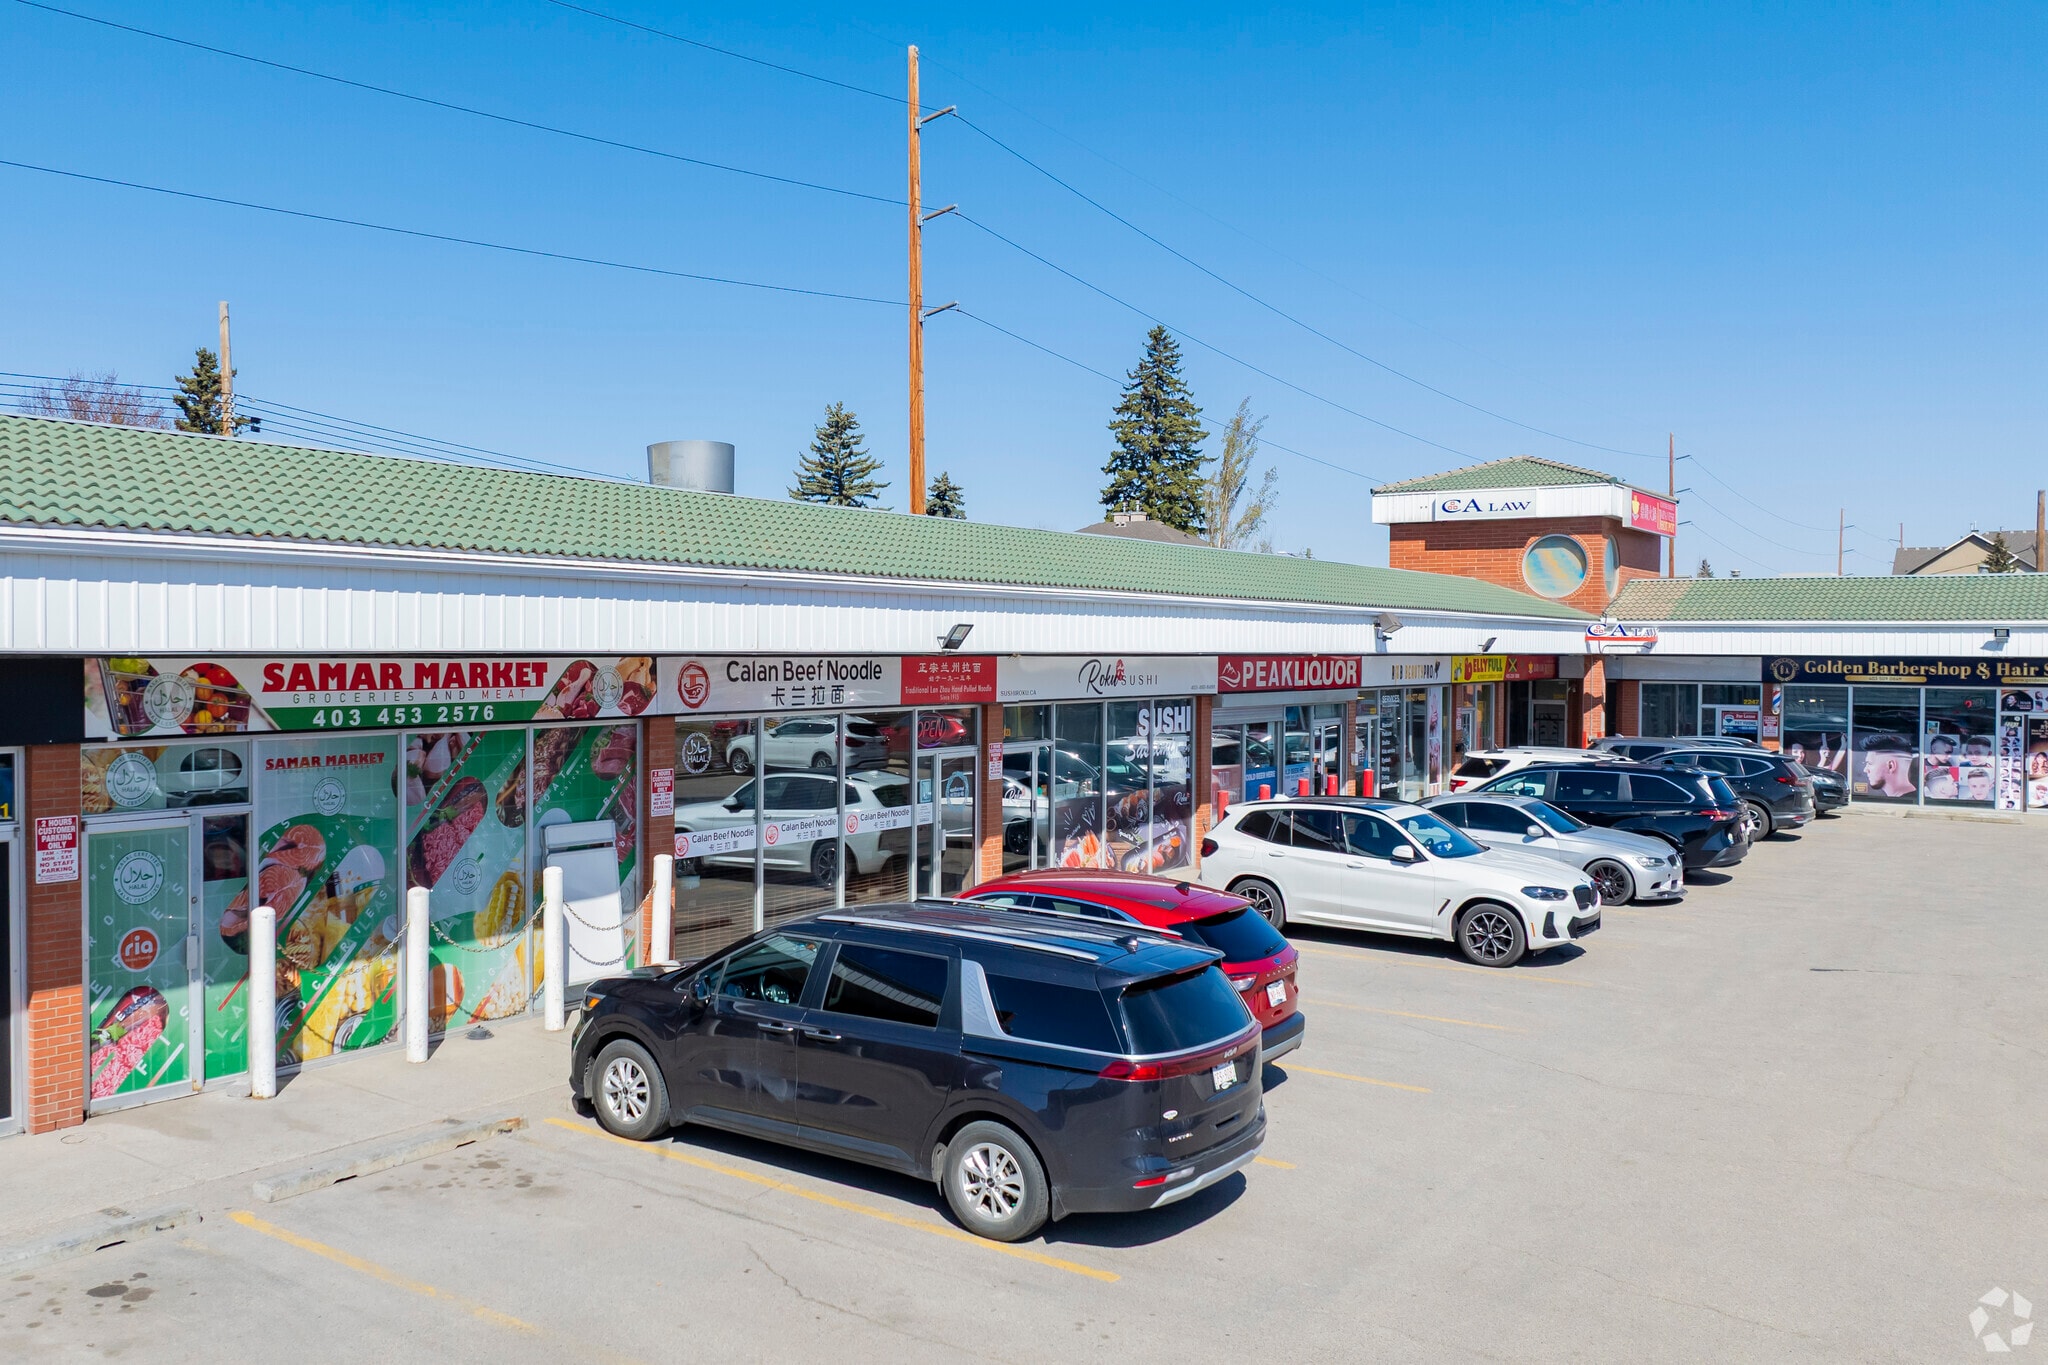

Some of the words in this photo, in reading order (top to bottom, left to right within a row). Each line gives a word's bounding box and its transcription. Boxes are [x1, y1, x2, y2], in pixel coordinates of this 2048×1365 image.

[1441, 498, 1483, 513] CA
[1489, 501, 1531, 512] LAW
[1587, 624, 1629, 637] CA
[1631, 627, 1660, 637] LAW
[262, 662, 404, 693] SAMAR
[414, 661, 548, 689] MARKET
[726, 660, 779, 683] Calan
[783, 659, 824, 682] Beef
[826, 659, 882, 681] Noodle
[1078, 659, 1118, 694] Roku
[1121, 675, 1158, 686] SUSHI
[1804, 660, 1863, 675] Golden
[1867, 661, 1971, 679] Barbershop
[1976, 662, 1991, 679] &
[1996, 662, 2040, 676] Hair
[293, 691, 415, 704] GROCERIES
[431, 689, 465, 701] AND
[481, 688, 526, 699] MEAT
[770, 684, 845, 706] 卡兰拉面
[905, 685, 929, 694] Traditional
[939, 685, 951, 693] Zhou
[951, 684, 963, 693] Hand
[963, 684, 977, 692] Pulled
[978, 684, 992, 692] Noodle
[312, 708, 362, 727] 403
[377, 707, 422, 725] 453
[437, 705, 494, 723] 2576
[1138, 706, 1191, 737] SUSHI
[918, 720, 944, 739] OPEN
[265, 756, 321, 770] SAMAR
[325, 752, 385, 766] MARKET
[687, 755, 707, 763] HALAL
[602, 763, 633, 807] BEEF
[41, 820, 47, 828] 2
[48, 818, 73, 827] HOURS
[860, 813, 877, 822] Calan
[877, 811, 890, 819] Beef
[890, 808, 910, 818] Noodle
[38, 825, 76, 836] CUSTOMER
[781, 822, 800, 832] Calan
[800, 819, 815, 831] Beef
[815, 817, 837, 828] Noodle
[41, 833, 72, 843] PARKING
[691, 834, 712, 844] Calan
[713, 831, 730, 841] Beef
[730, 828, 755, 840] Noodle
[47, 840, 67, 850] ONLY
[41, 866, 73, 875] PARKING
[128, 882, 148, 890] HALAL
[125, 935, 154, 957] ria
